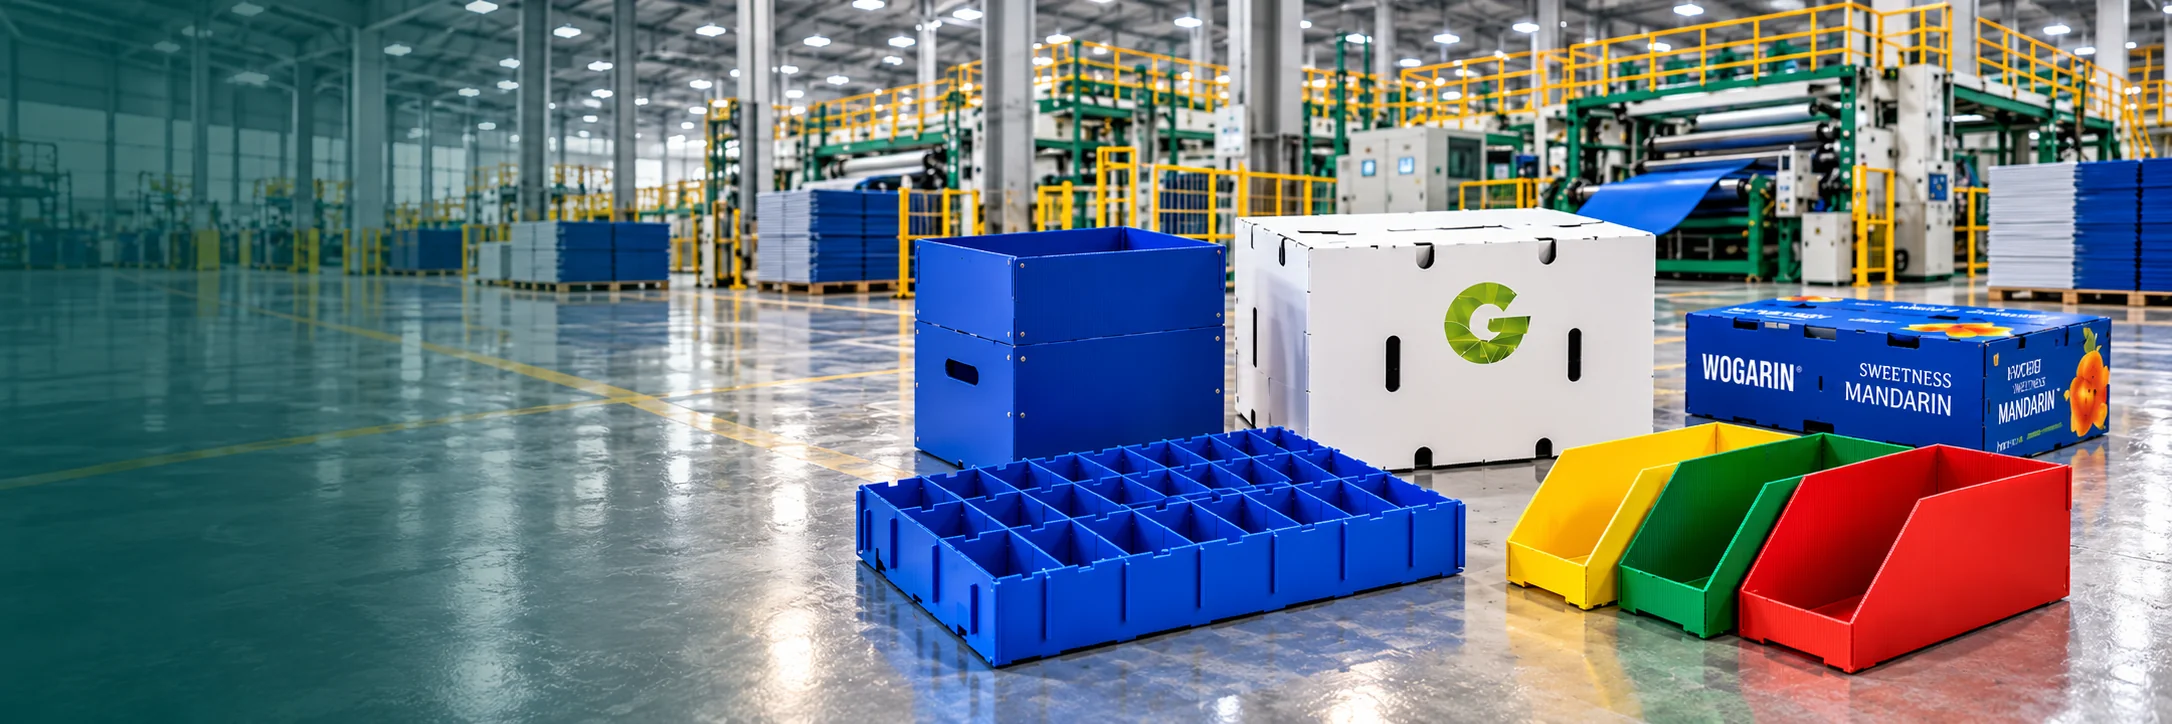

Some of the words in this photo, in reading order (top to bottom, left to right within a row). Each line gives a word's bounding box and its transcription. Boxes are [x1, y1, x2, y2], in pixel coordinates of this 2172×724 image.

[1443, 281, 1530, 365] G
[1859, 362, 1952, 389] SWEETNESS
[1845, 381, 1952, 417] MANDARIN
